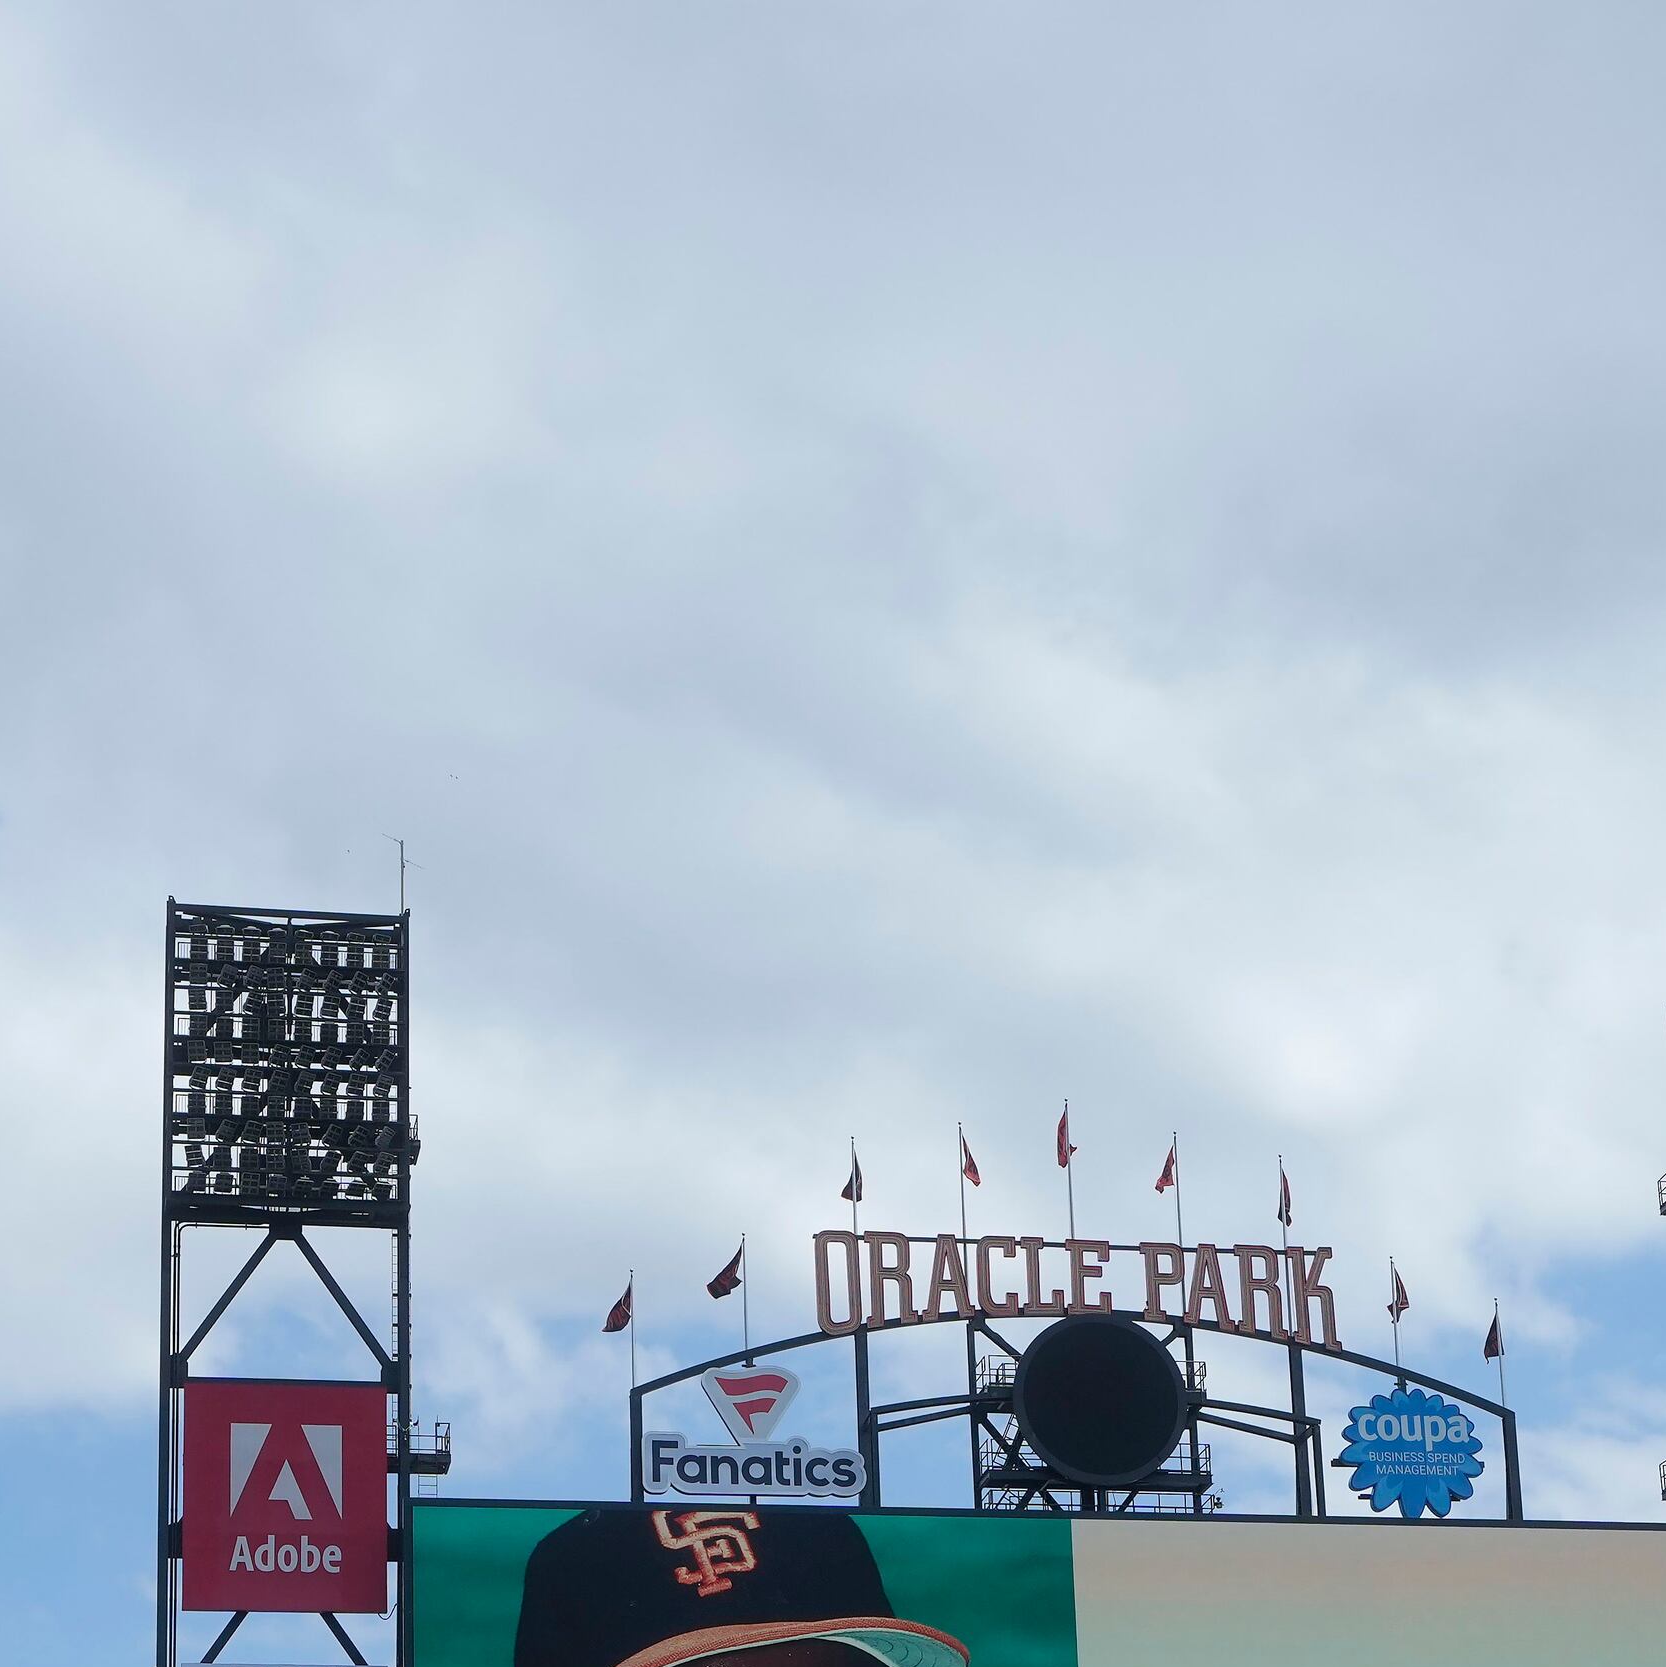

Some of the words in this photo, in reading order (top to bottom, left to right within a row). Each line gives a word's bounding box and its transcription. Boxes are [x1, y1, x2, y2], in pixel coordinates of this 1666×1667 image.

[813, 1230, 1112, 1335] ORACLE
[1139, 1241, 1342, 1352] PARK
[1358, 1413, 1469, 1452] coupa
[652, 1440, 857, 1488] Fanatics
[1369, 1452, 1425, 1463] BUSINESS
[1427, 1453, 1465, 1463] SPEND
[1376, 1464, 1459, 1476] MANAGEMENT
[229, 1534, 342, 1573] Adobe
